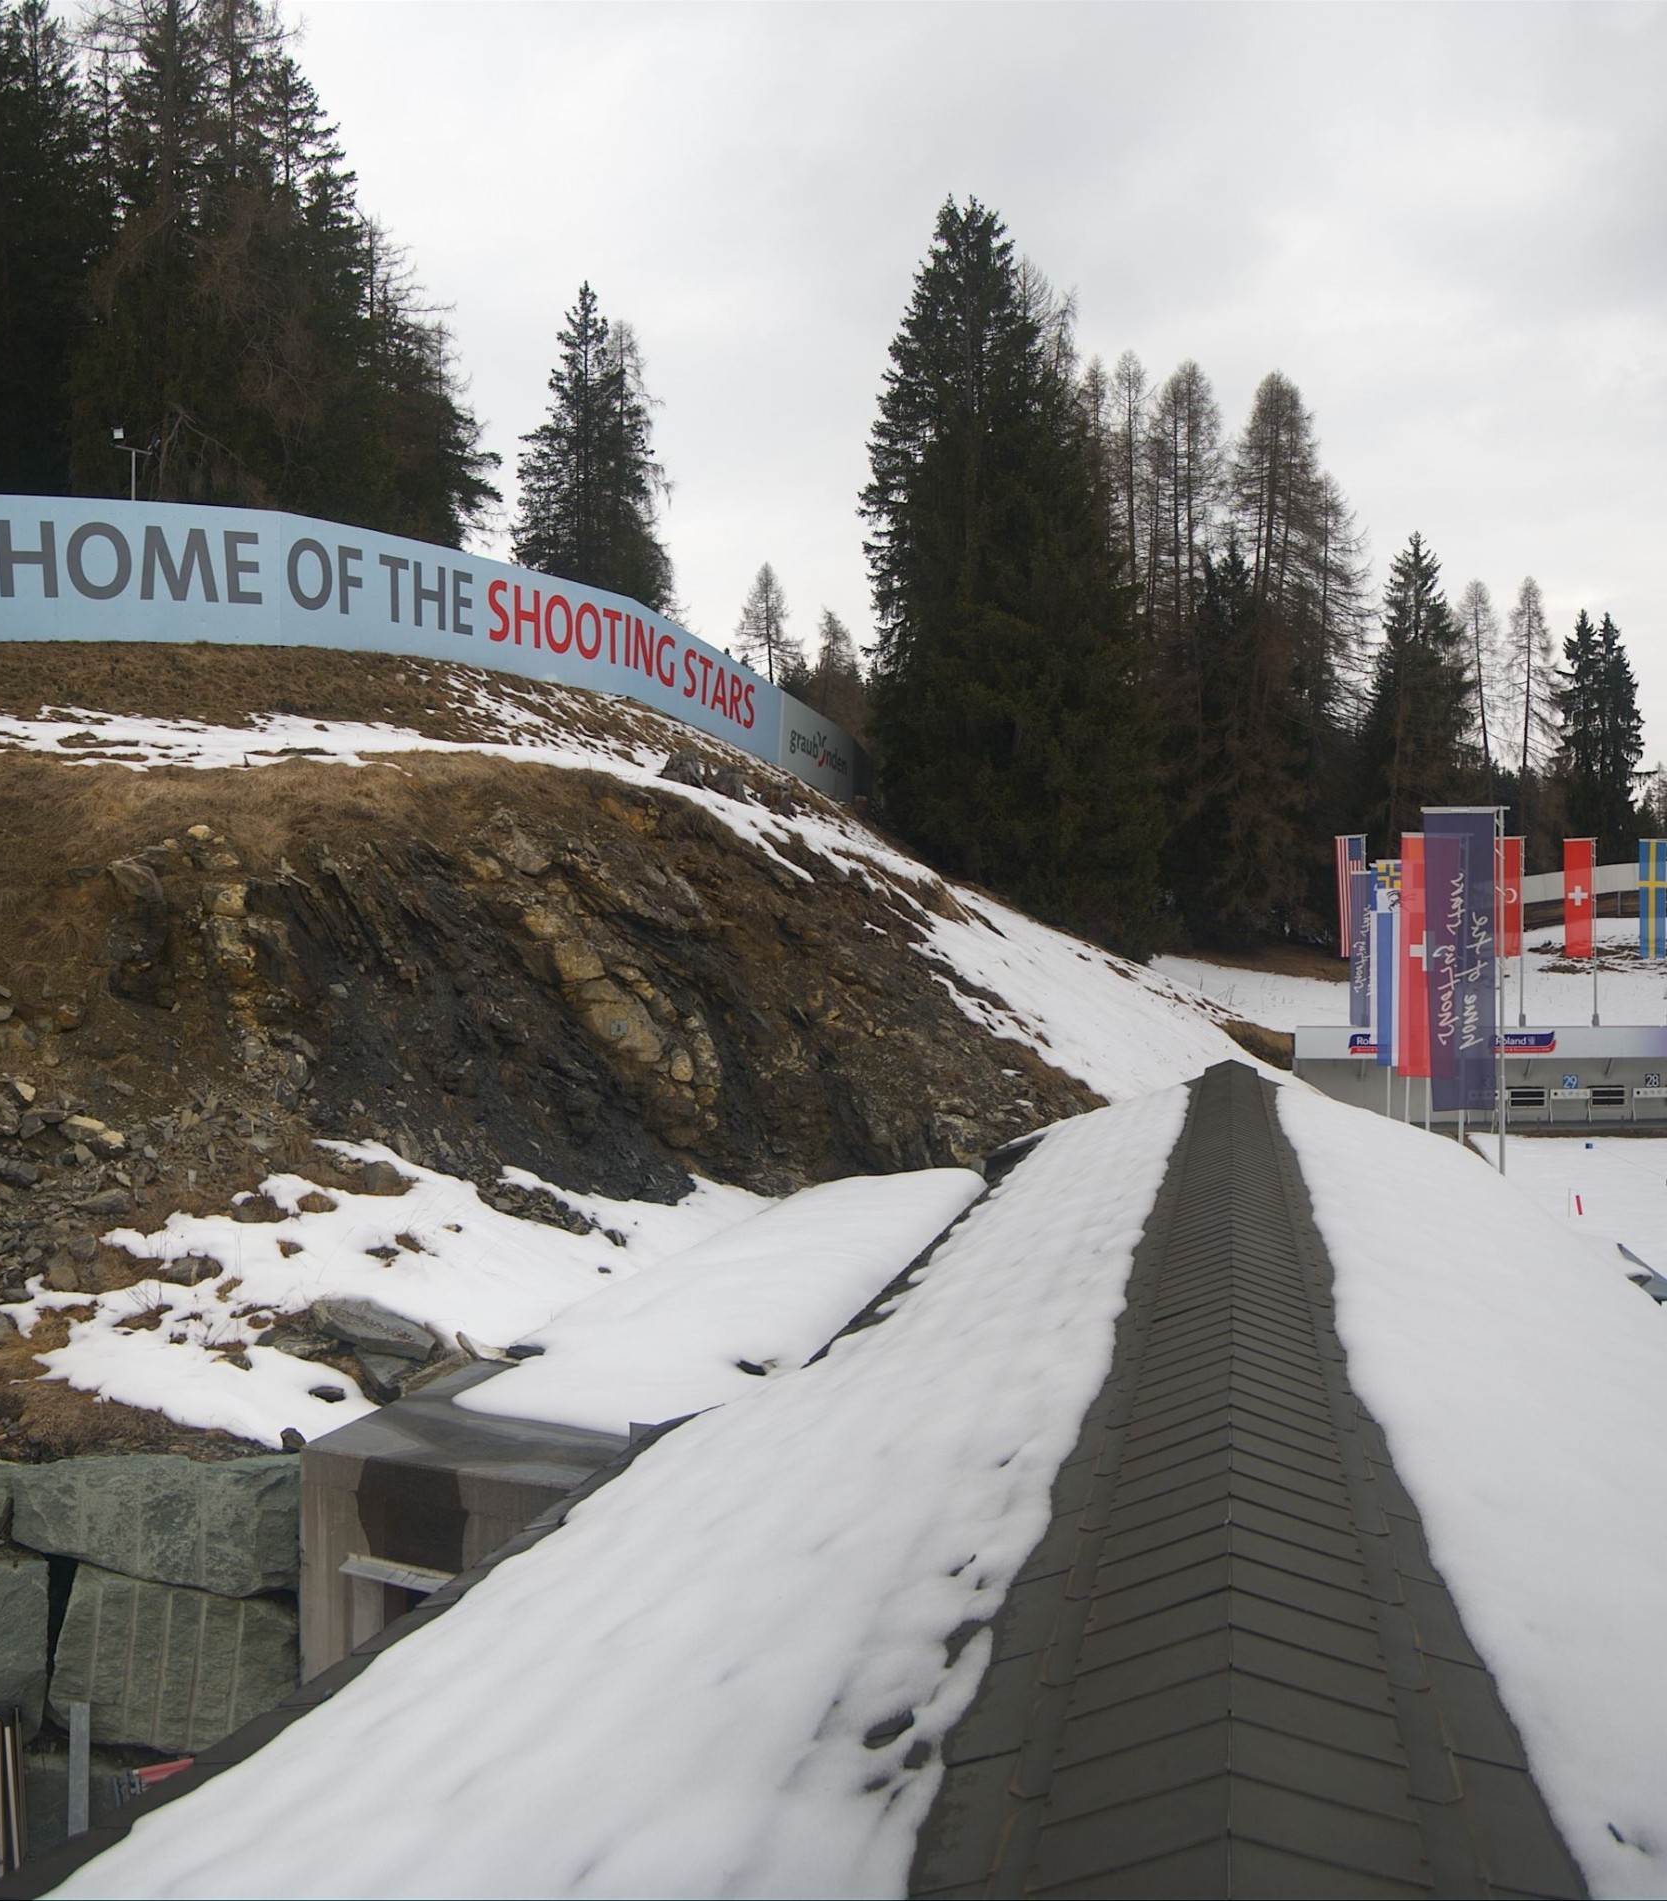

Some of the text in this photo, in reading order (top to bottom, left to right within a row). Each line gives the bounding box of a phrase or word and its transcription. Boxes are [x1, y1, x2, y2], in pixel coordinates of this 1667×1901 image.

[287, 537, 363, 615] OF
[379, 553, 474, 636] THE
[487, 578, 677, 689] SHOOTING
[682, 648, 757, 730] STARS
[1563, 1075, 1578, 1088] 29
[1646, 1073, 1660, 1087] 28
